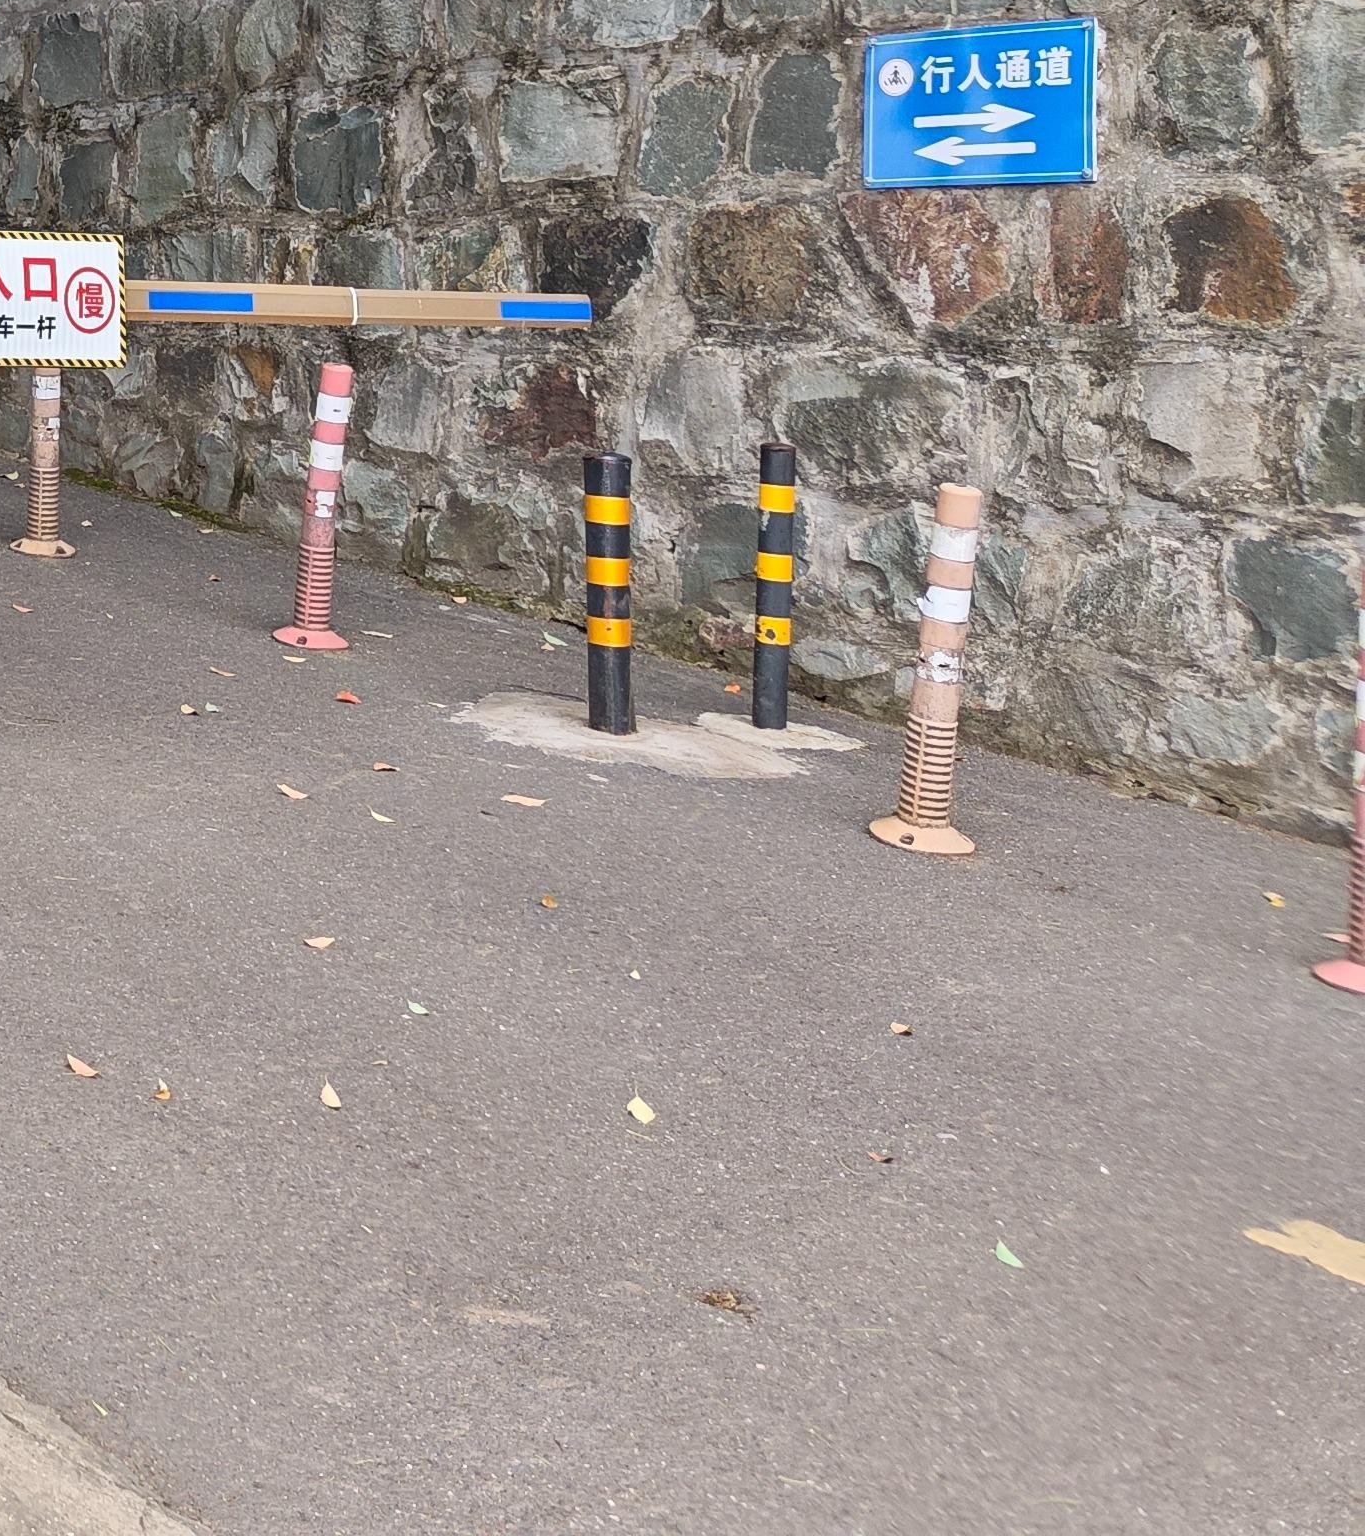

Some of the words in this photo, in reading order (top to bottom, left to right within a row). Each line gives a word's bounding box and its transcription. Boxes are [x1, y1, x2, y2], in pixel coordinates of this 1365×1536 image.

[920, 45, 1073, 95] 行人通道
[75, 281, 105, 319] 慢
